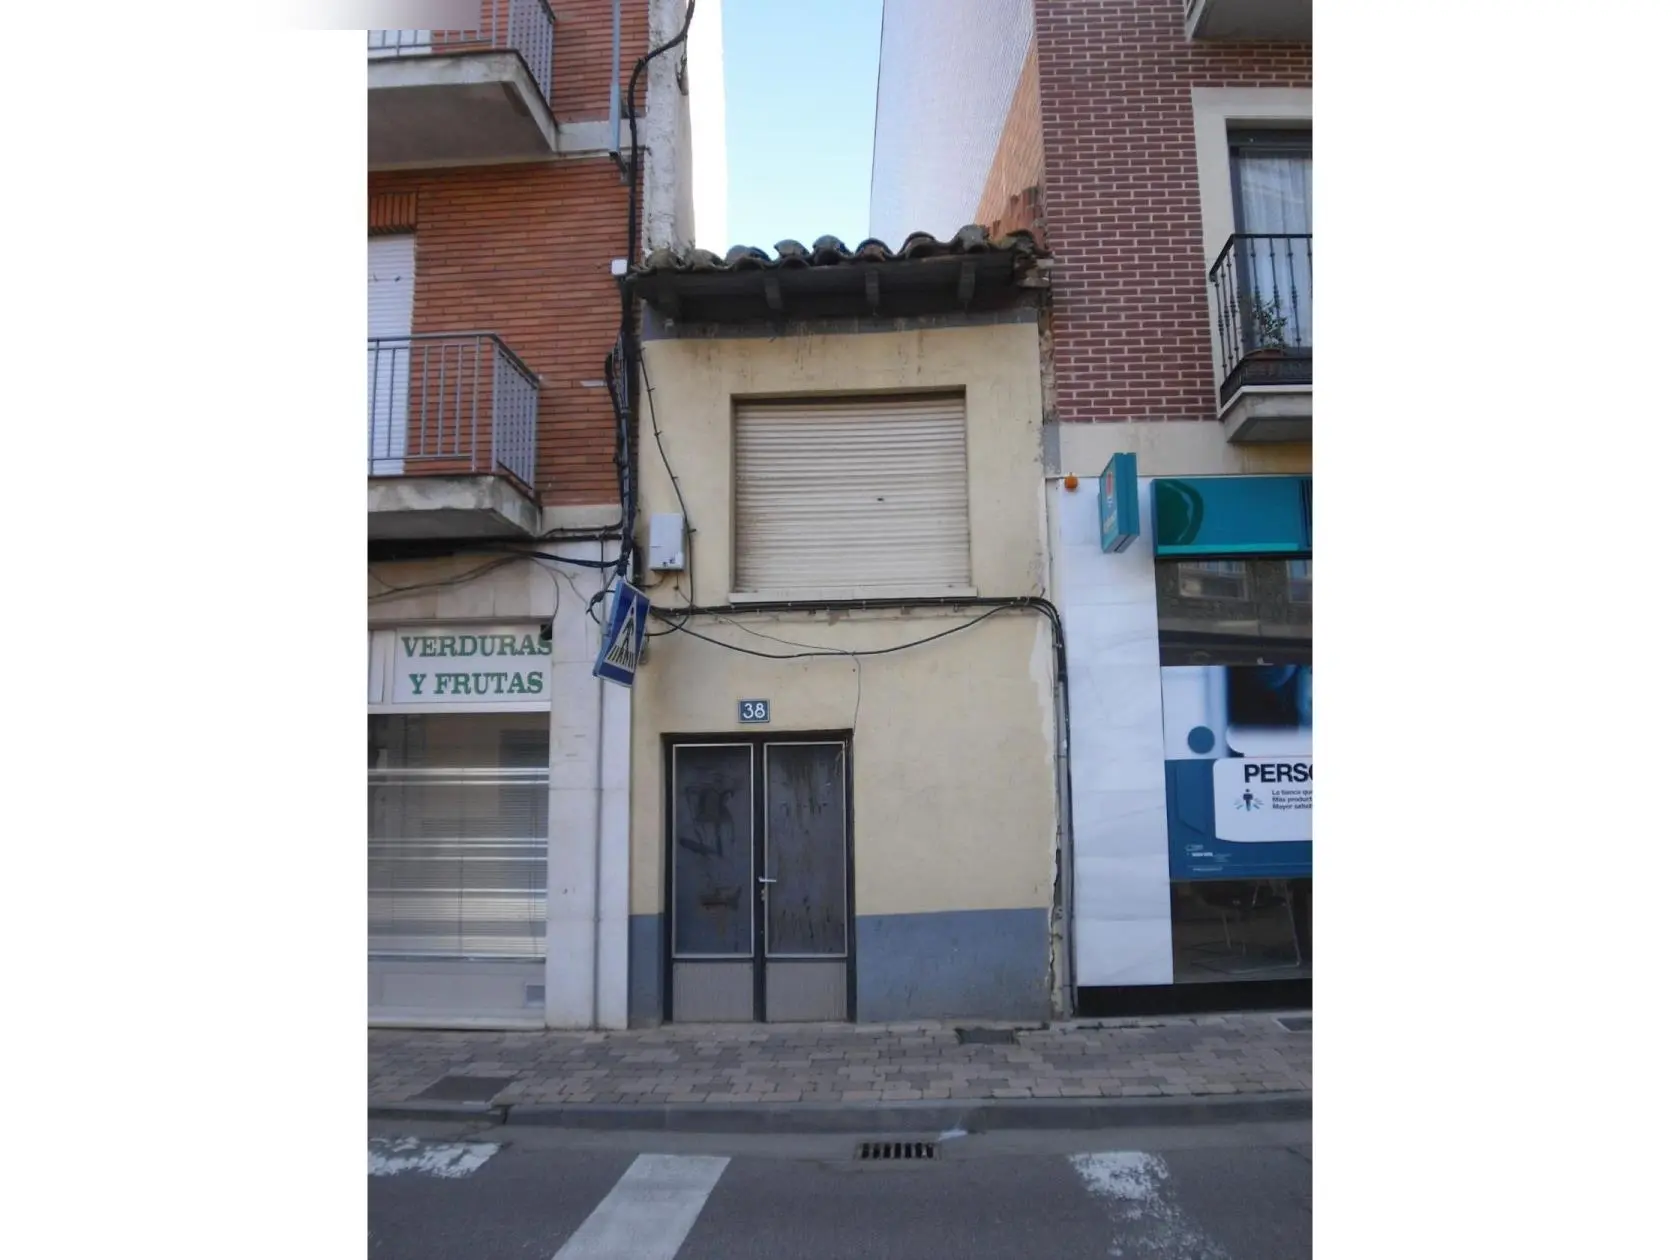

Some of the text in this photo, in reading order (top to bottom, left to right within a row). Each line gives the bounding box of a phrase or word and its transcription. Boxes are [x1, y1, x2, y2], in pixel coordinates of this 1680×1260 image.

[401, 634, 553, 657] VERDURAS
[409, 672, 543, 694] Y FRUTAS
[743, 702, 766, 719] 38
